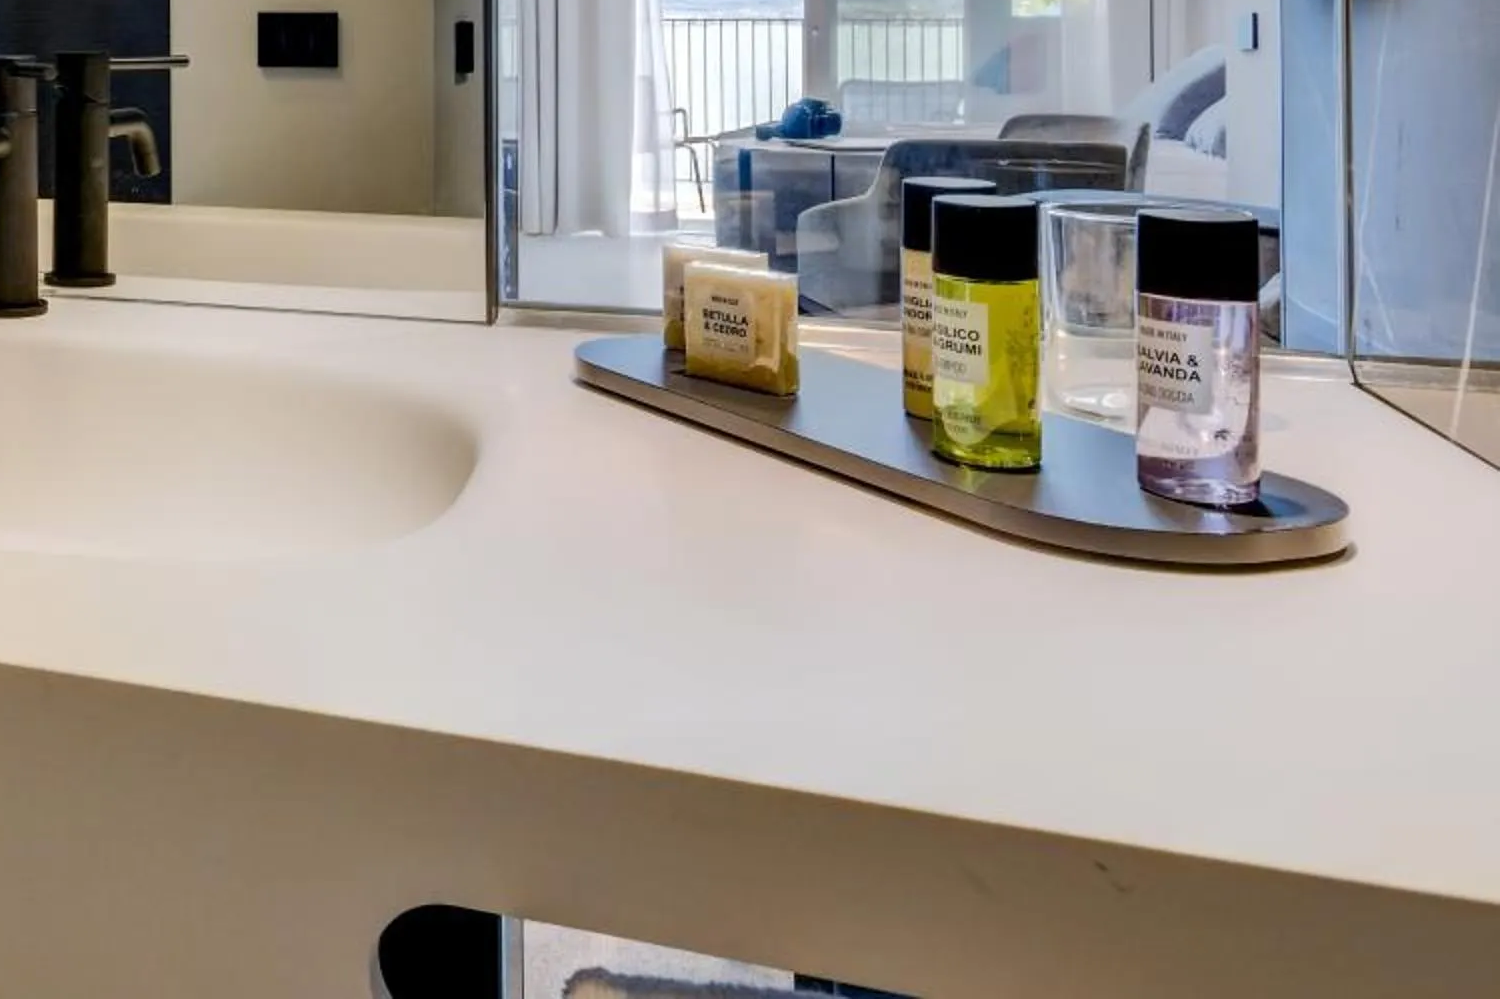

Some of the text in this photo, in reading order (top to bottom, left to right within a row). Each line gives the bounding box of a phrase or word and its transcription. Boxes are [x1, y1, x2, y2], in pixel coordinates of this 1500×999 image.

[702, 308, 749, 326] BETULLA
[713, 323, 748, 338] CEDRO
[1187, 354, 1199, 368] &
[1139, 360, 1202, 383] AVANDA
